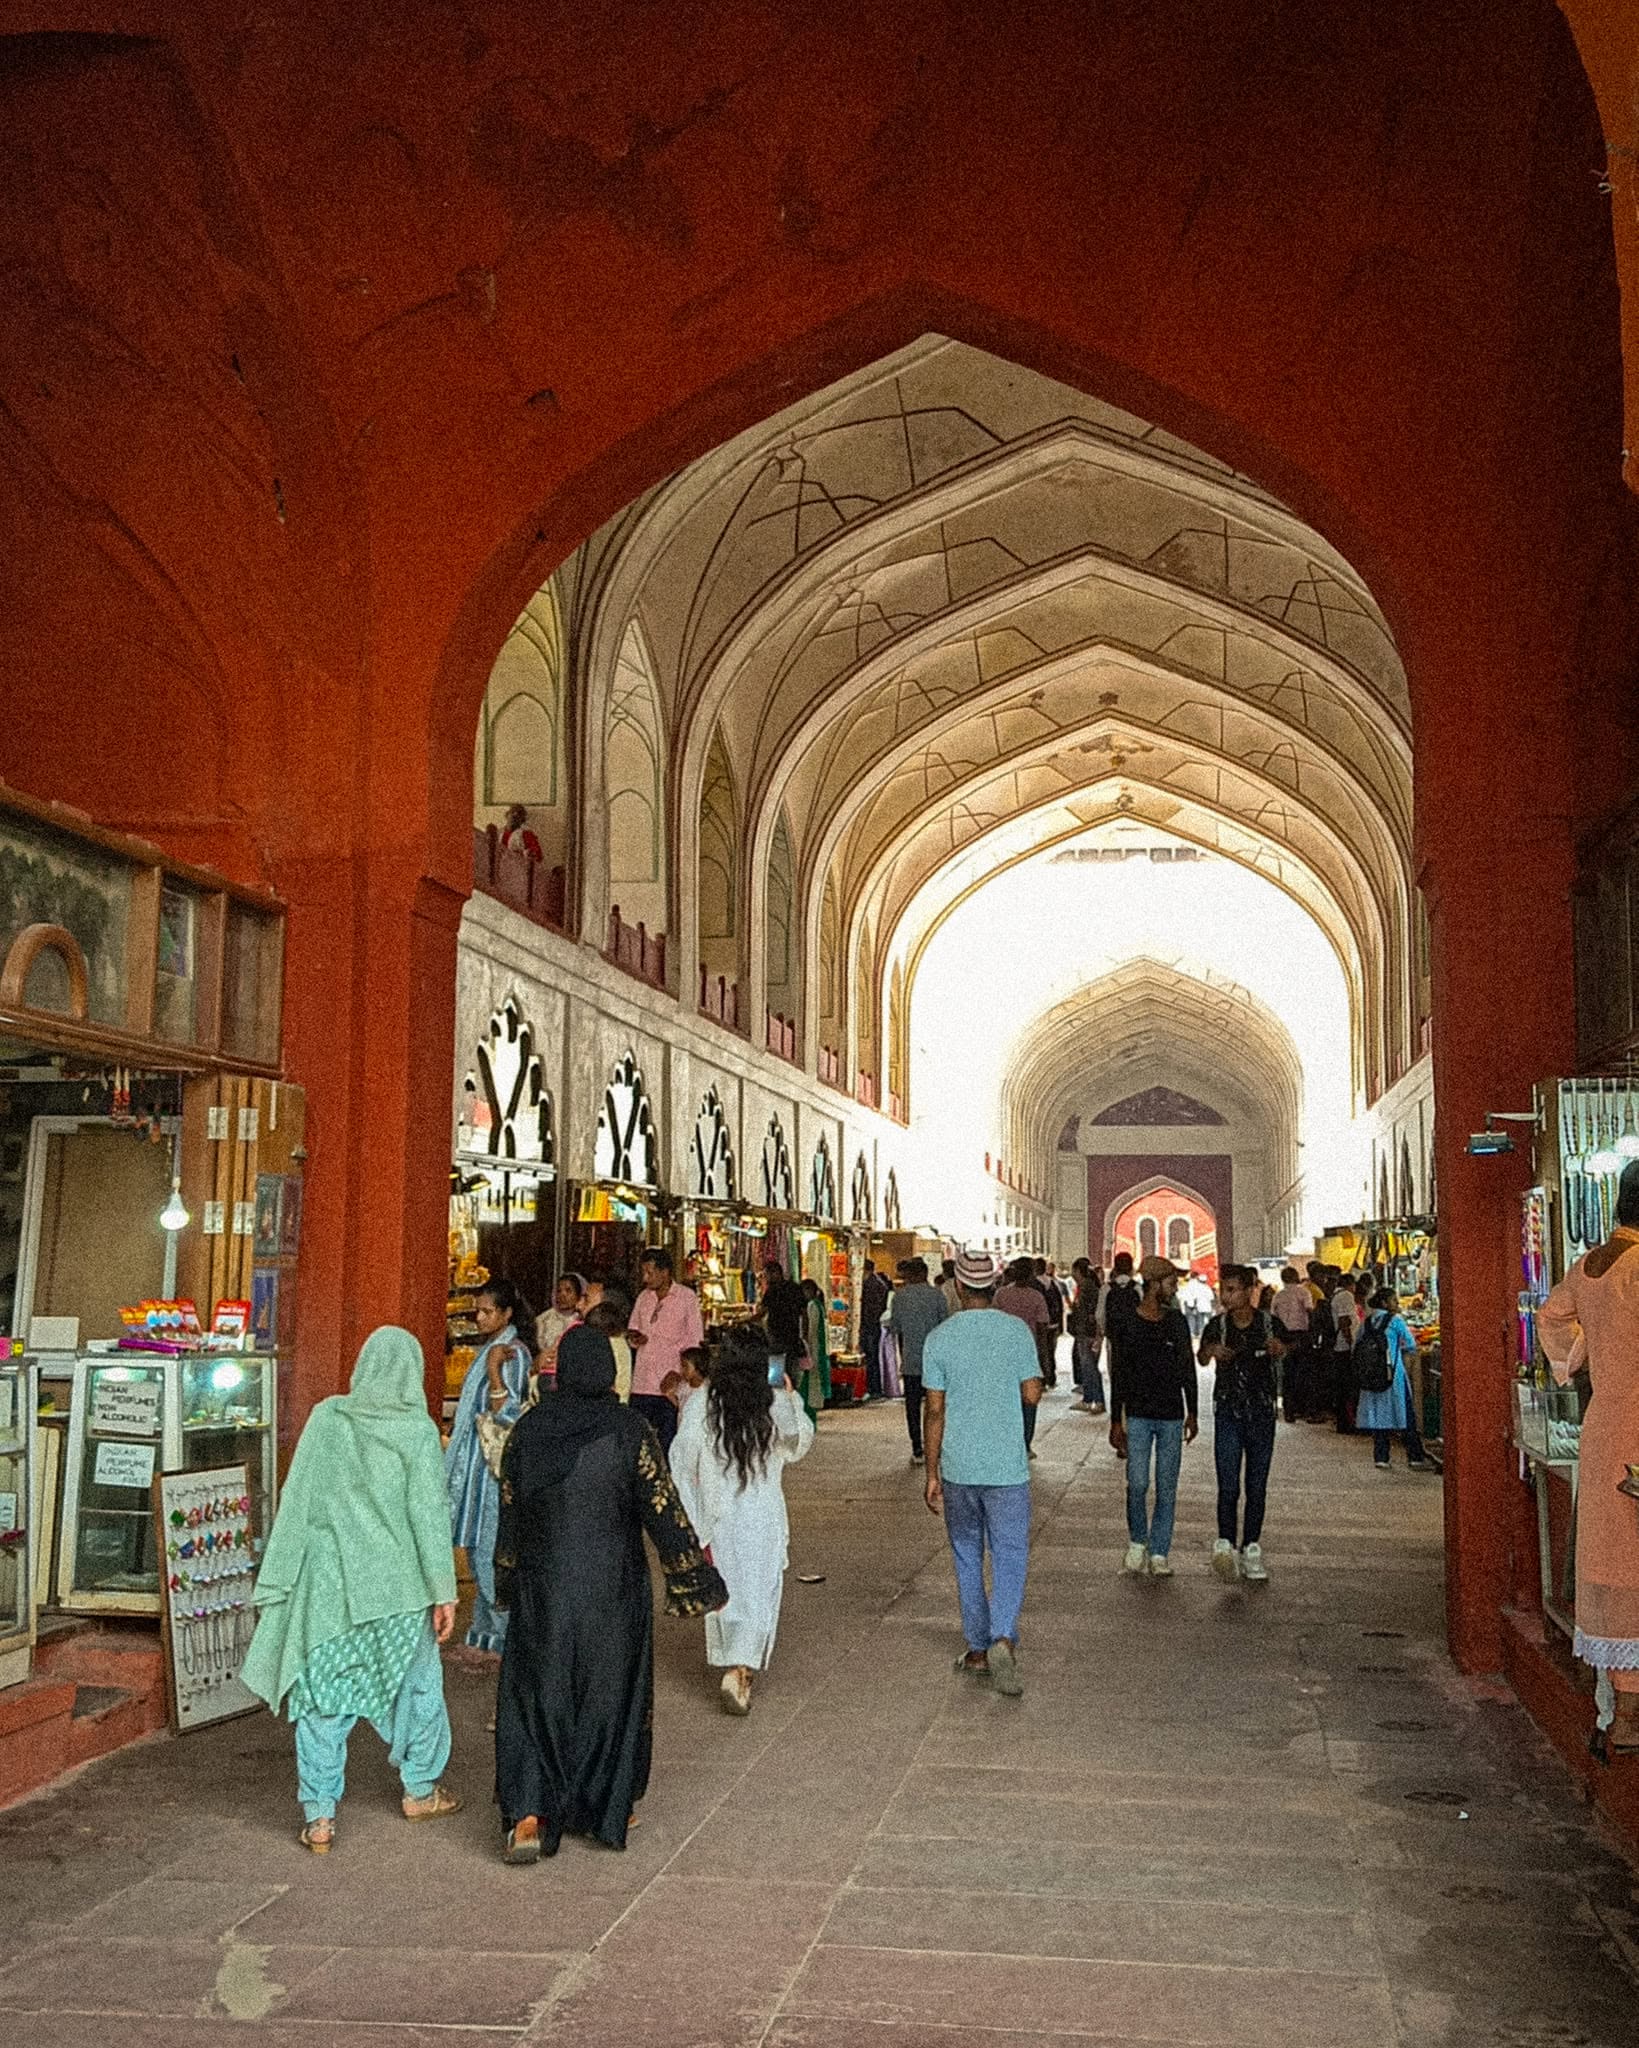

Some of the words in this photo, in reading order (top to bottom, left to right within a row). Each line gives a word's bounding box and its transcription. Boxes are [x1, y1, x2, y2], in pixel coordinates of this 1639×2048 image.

[112, 1395, 155, 1406] PERFUMES
[98, 1403, 117, 1411] NON
[101, 1413, 148, 1423] ALCOHOLIC
